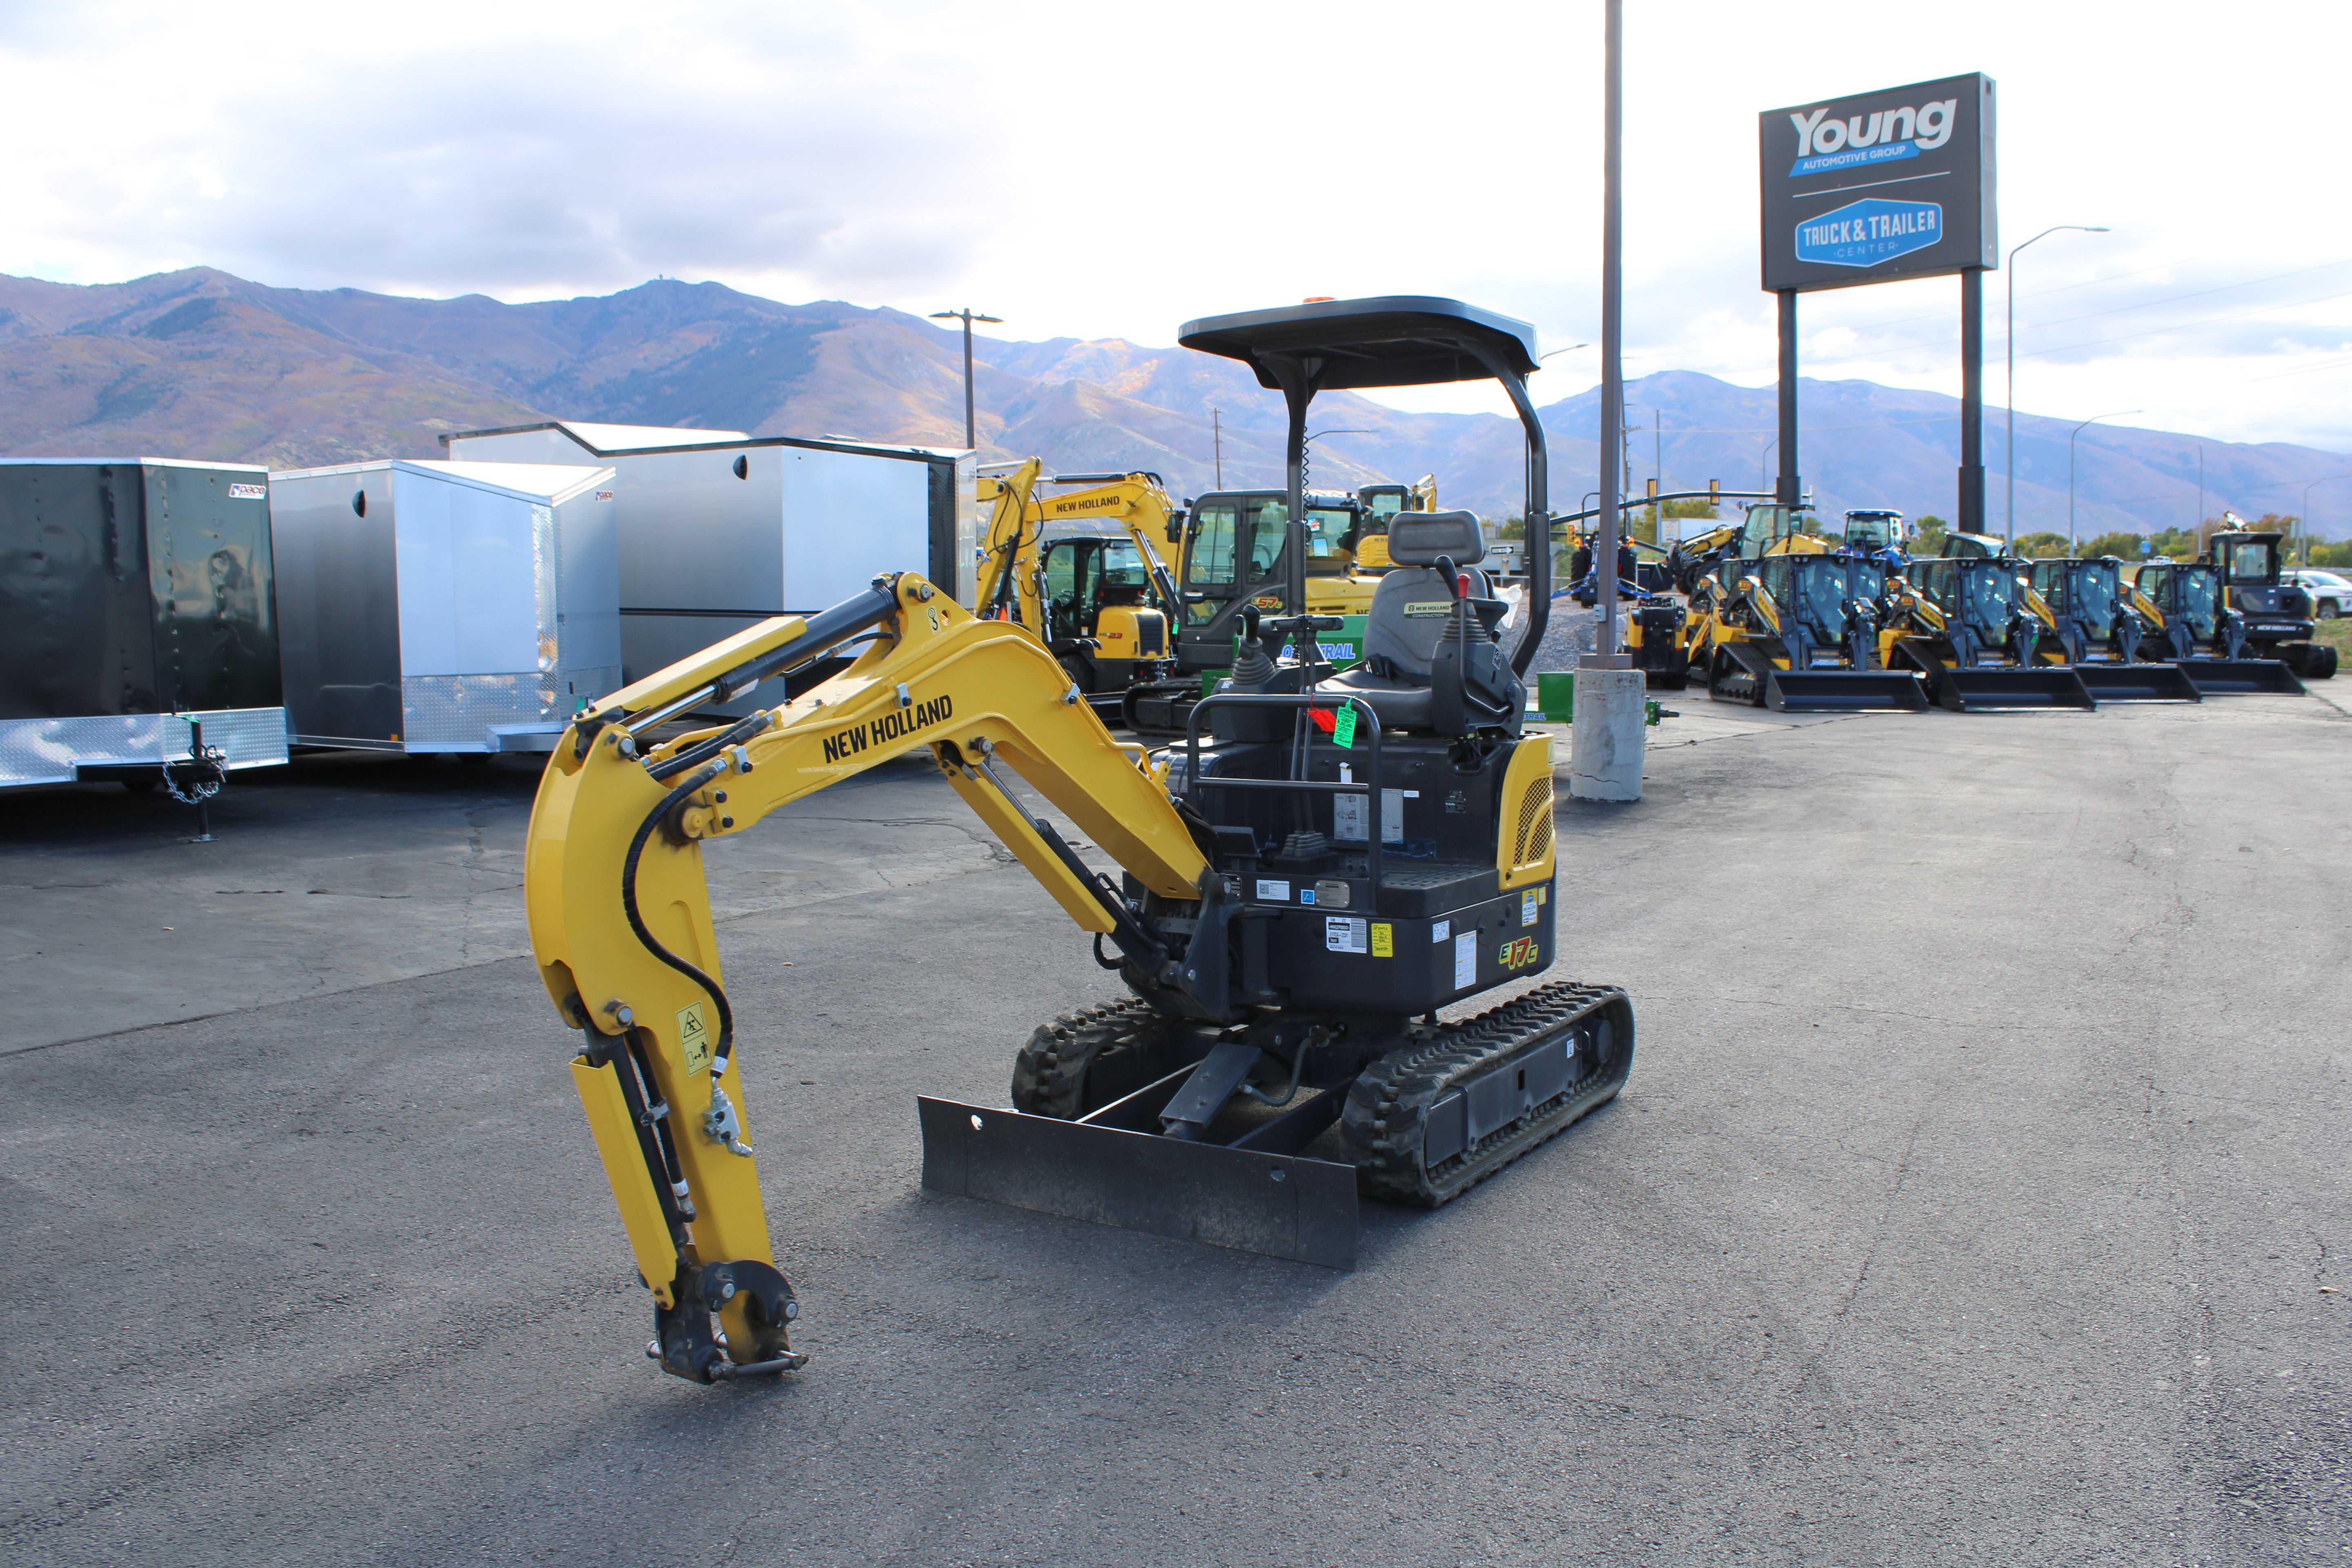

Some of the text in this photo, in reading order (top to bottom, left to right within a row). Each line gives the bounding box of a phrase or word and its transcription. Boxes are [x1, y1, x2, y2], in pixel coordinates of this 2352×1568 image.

[1789, 98, 1957, 158] Young
[1803, 145, 1906, 170] AUTOMOTIVE GROUP
[1804, 210, 1935, 246] TRUCK & TRAILER
[1837, 242, 1896, 257] CENTER
[1056, 496, 1120, 512] NEW HOLLAND
[1252, 597, 1283, 608] E57C
[1319, 644, 1356, 659] TRAIL
[1523, 713, 1546, 721] TRAIL
[822, 695, 953, 764] NEW HOLLAND
[1499, 936, 1539, 970] E17C
